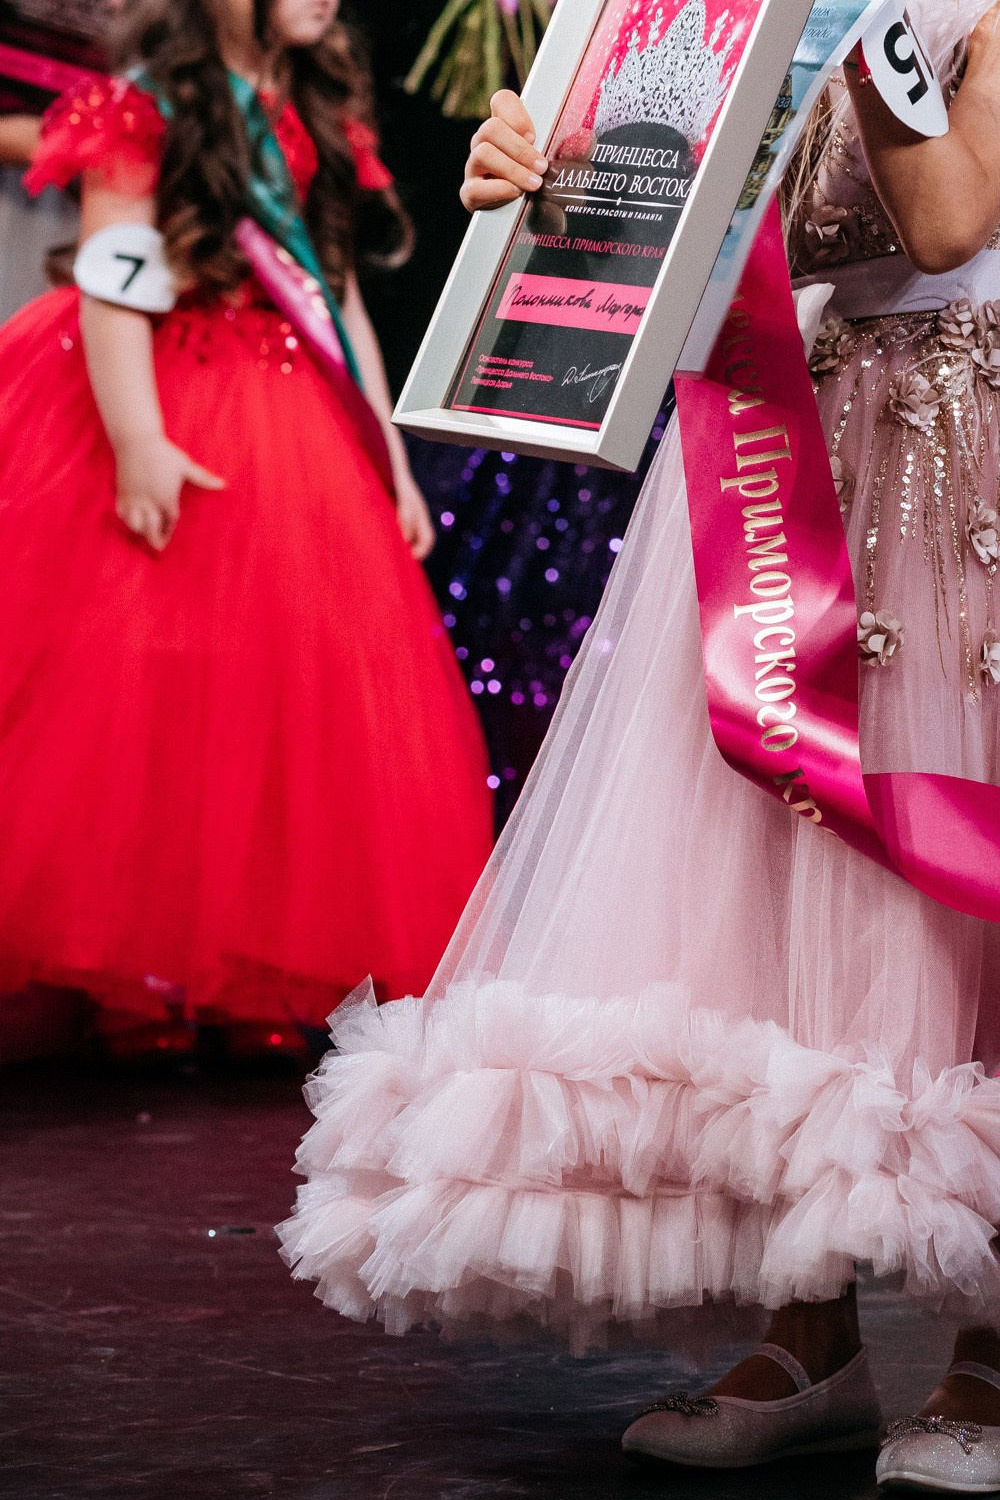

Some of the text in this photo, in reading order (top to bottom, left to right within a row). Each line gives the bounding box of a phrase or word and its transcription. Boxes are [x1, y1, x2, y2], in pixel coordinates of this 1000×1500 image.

[590, 144, 680, 169] ПРИНЦЕССА
[552, 169, 627, 192] ДАЛЬНЕГО
[564, 205, 596, 215] КОНКУРС
[596, 208, 627, 218] КРАСОТЫ
[634, 212, 663, 221] ТАЛАНТА
[517, 232, 668, 259] ПРИНЦЕССА ПРИМОРСКОГО КРАЯ
[114, 253, 146, 292] 7
[720, 424, 798, 753] Приморского
